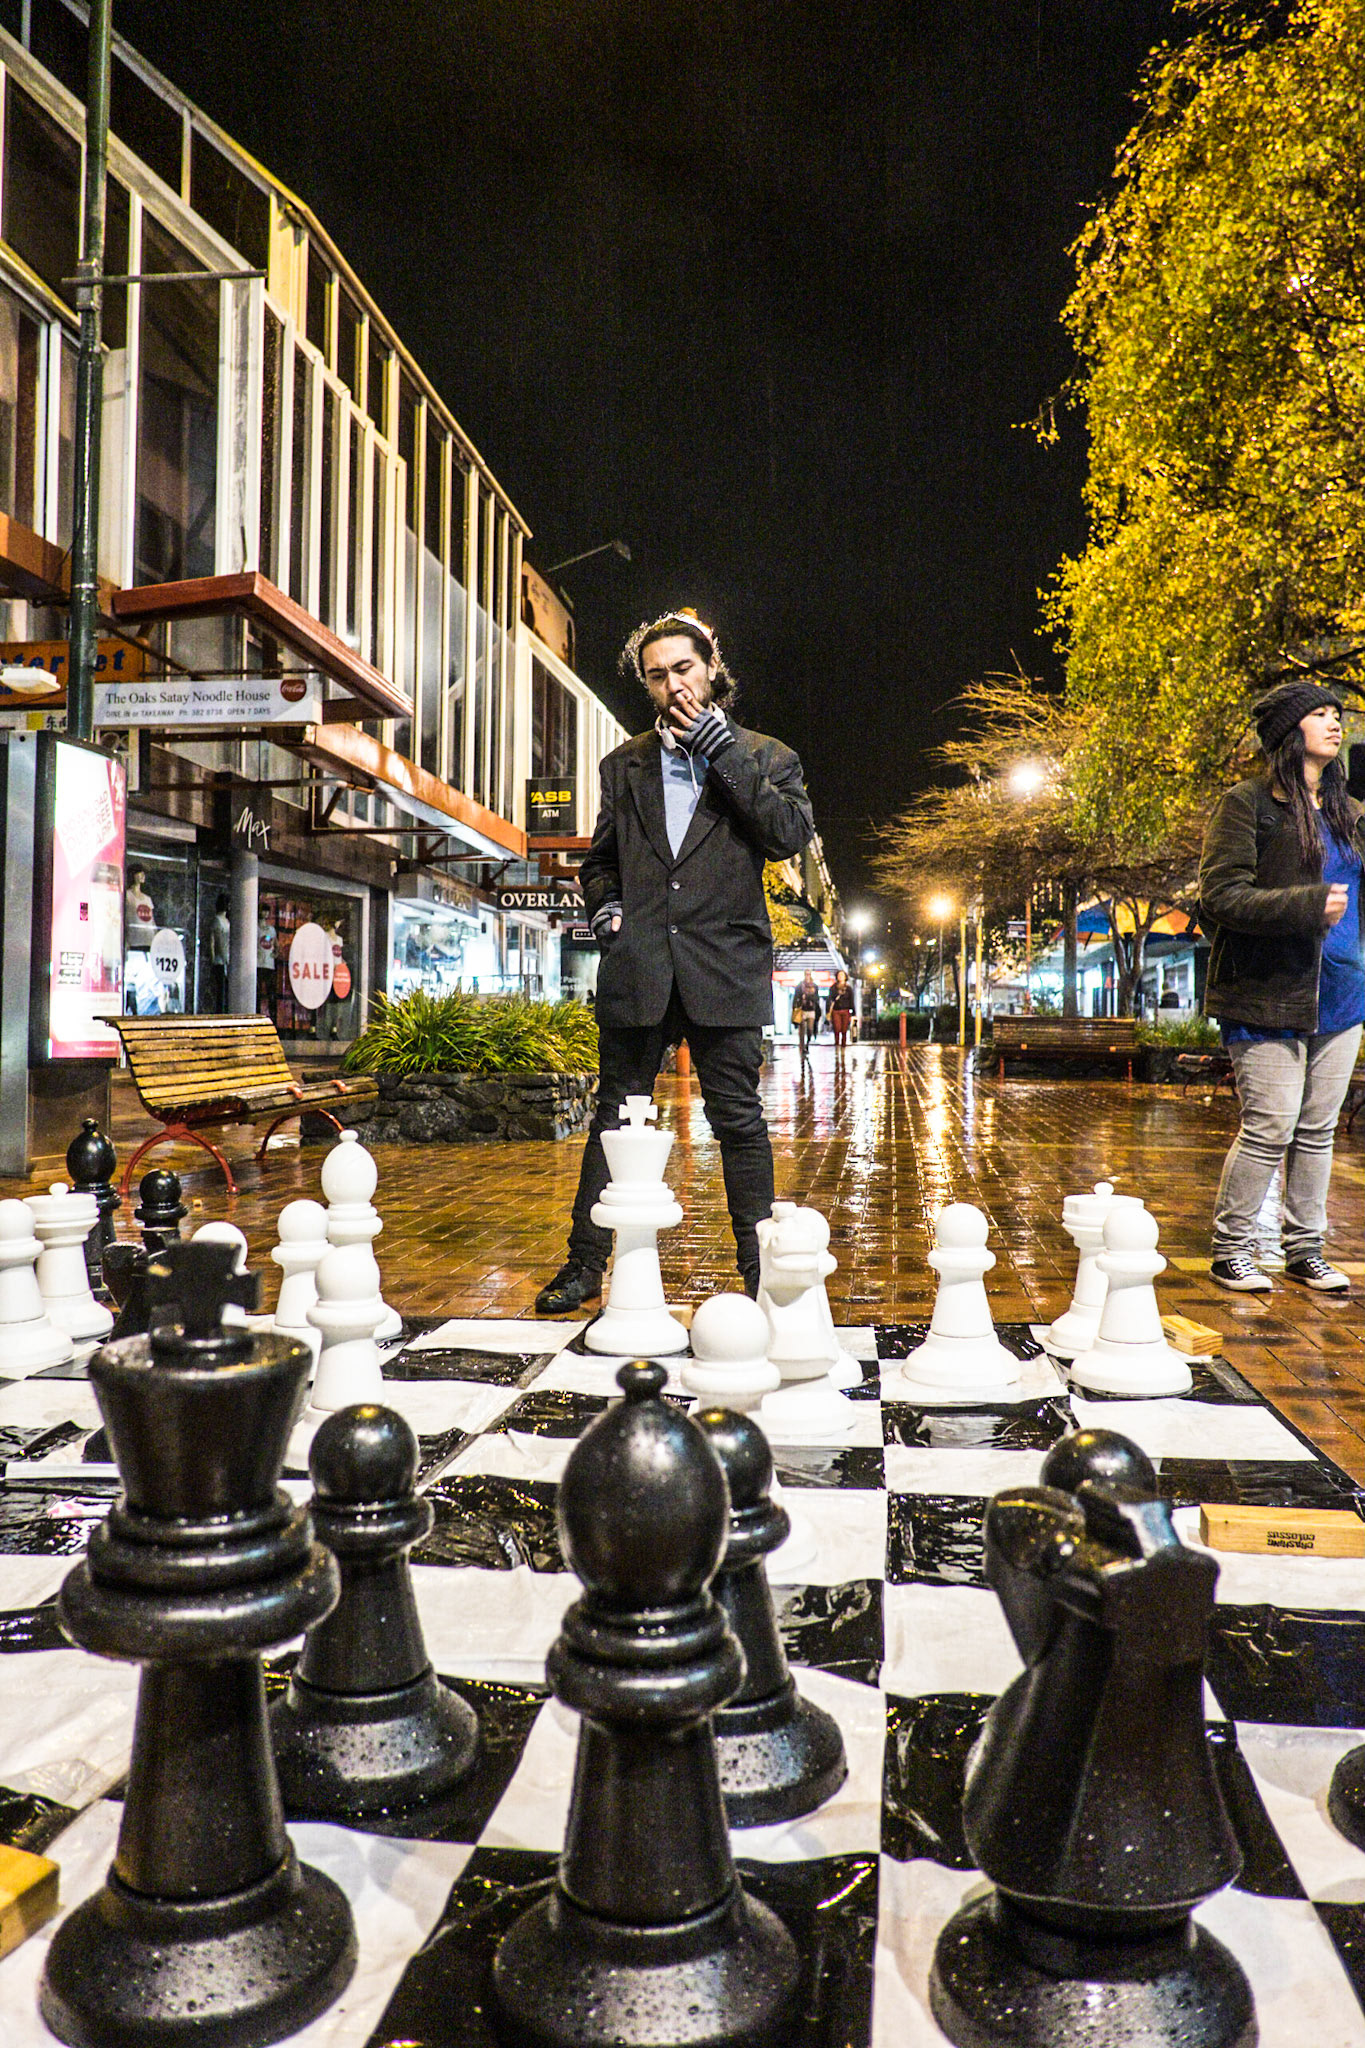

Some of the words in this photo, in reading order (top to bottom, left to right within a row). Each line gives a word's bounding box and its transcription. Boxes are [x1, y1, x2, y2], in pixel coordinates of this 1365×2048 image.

[0, 648, 126, 673] teret
[105, 692, 127, 705] The
[129, 691, 157, 704] Oaks
[159, 691, 190, 705] Satay
[192, 690, 233, 702] Noodle
[235, 689, 271, 702] House
[140, 709, 175, 717] TAKEAWAY
[227, 707, 246, 715] OPEN
[253, 706, 272, 715] DAYS
[541, 809, 560, 819] ATM
[233, 806, 271, 850] Max
[500, 892, 586, 908] OVERLAN
[155, 956, 179, 972] $129
[292, 961, 330, 980] SALE
